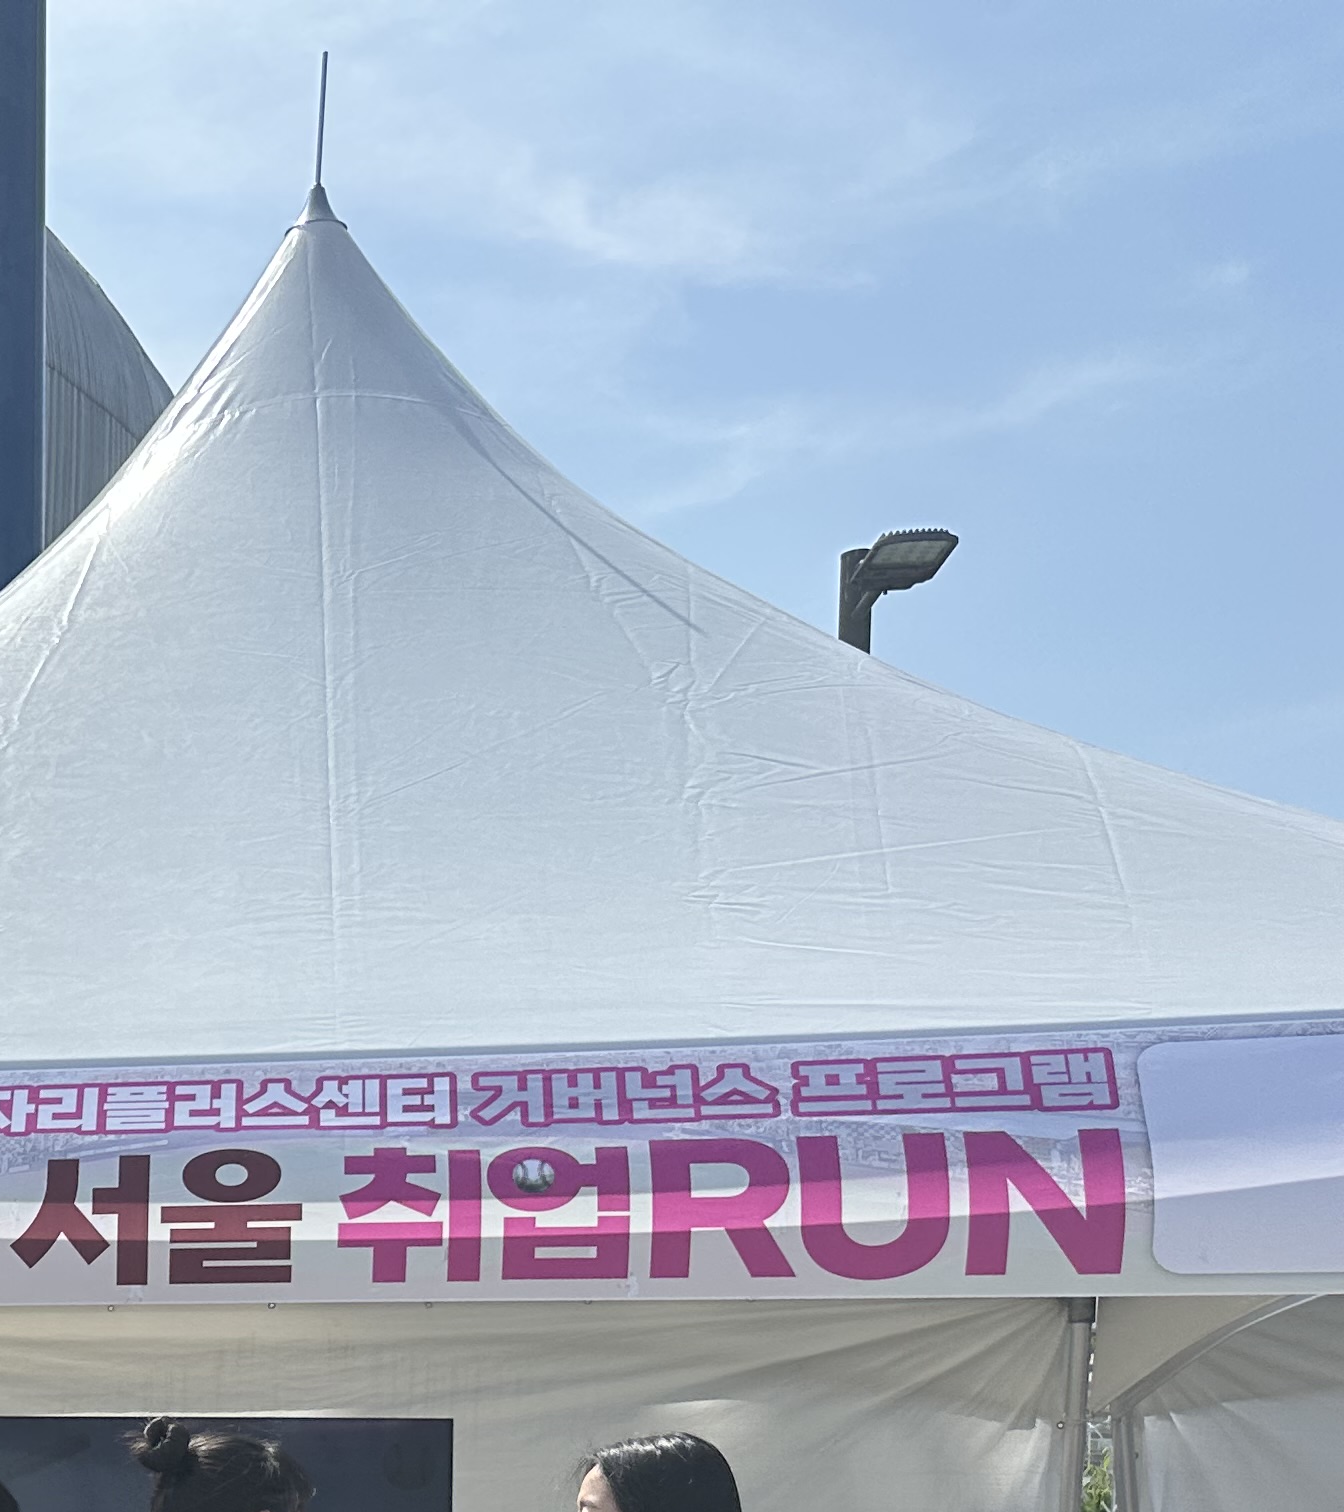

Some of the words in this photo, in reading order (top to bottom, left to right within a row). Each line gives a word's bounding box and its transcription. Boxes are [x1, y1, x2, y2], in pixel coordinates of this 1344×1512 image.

[469, 1063, 781, 1128] 거버넌스
[788, 1047, 1120, 1119] 프로그램
[11, 1148, 303, 1285] 서울
[336, 1127, 1128, 1284] 취업RUN
